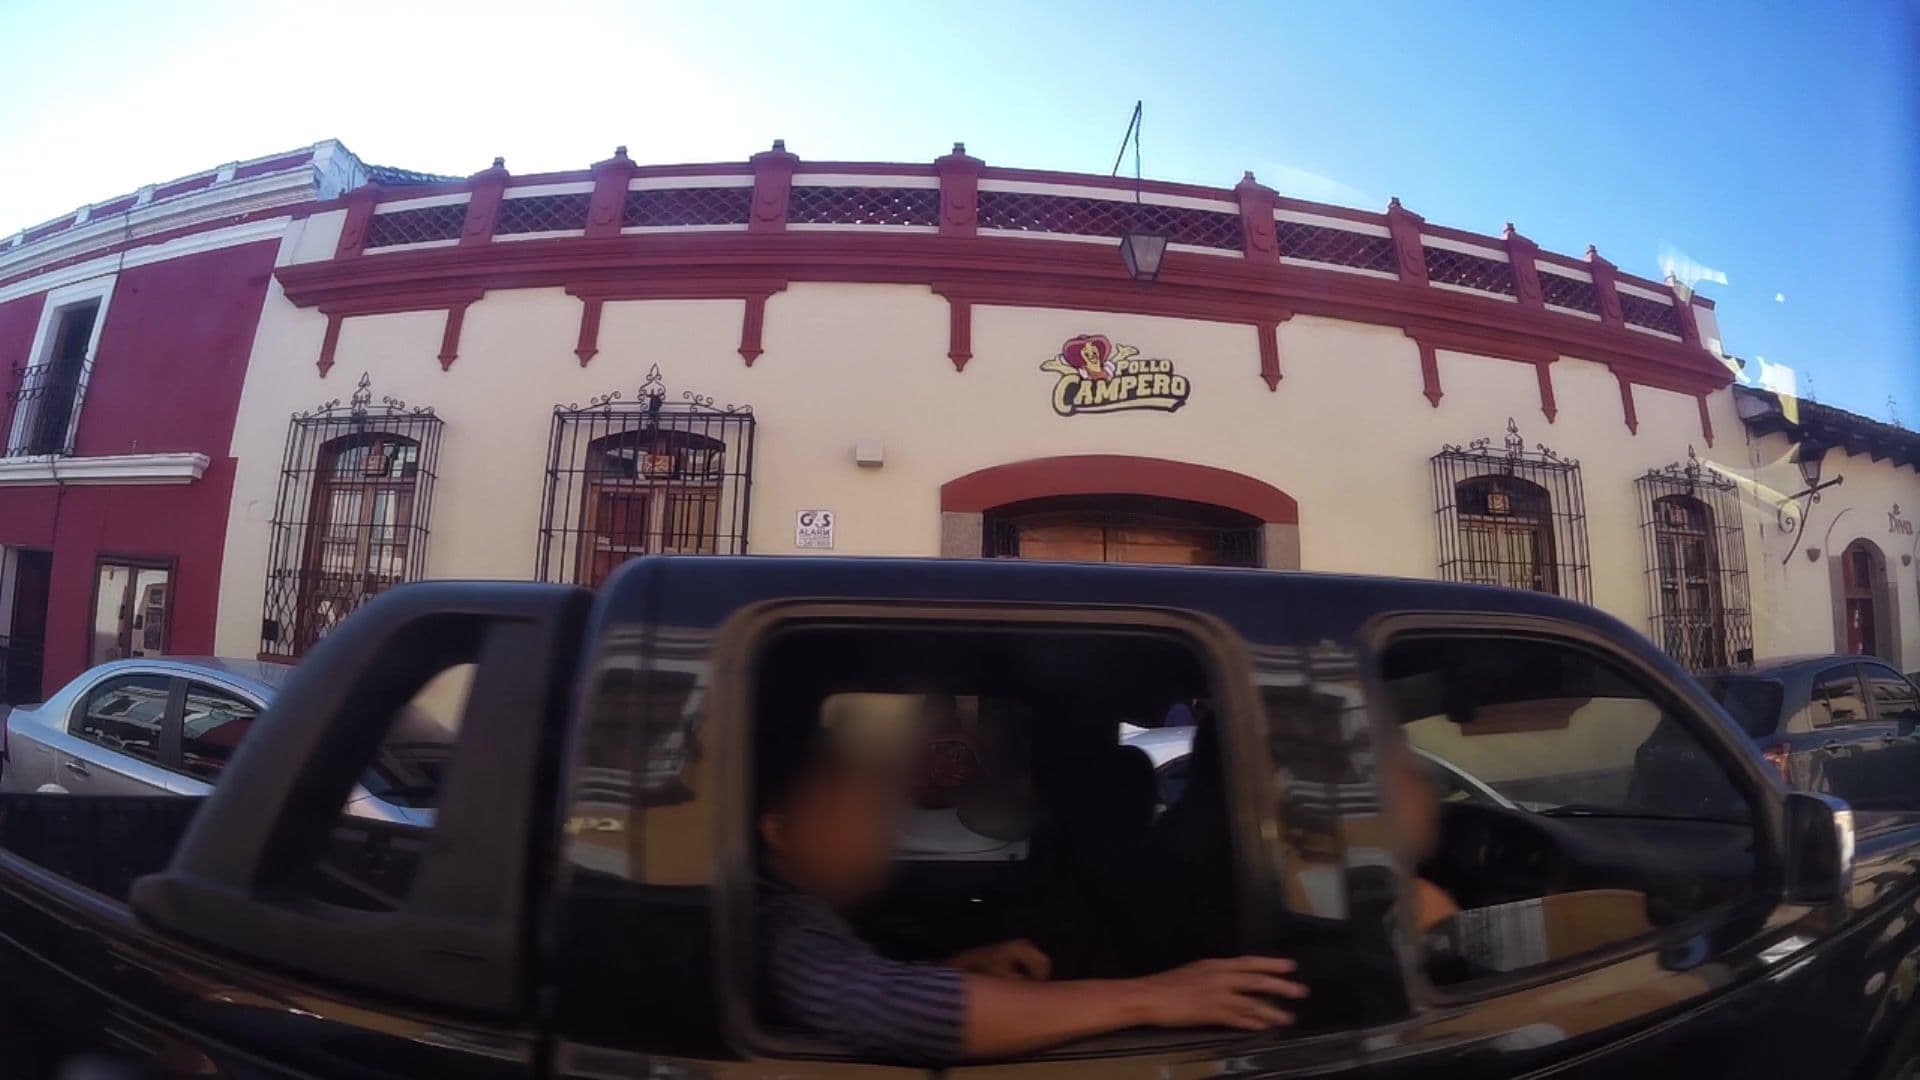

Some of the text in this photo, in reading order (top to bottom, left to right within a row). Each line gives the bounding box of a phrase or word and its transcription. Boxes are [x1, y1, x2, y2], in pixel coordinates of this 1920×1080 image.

[1115, 359, 1172, 376] POLLO
[1054, 373, 1188, 415] CAMPERO
[799, 528, 831, 537] ALARM
